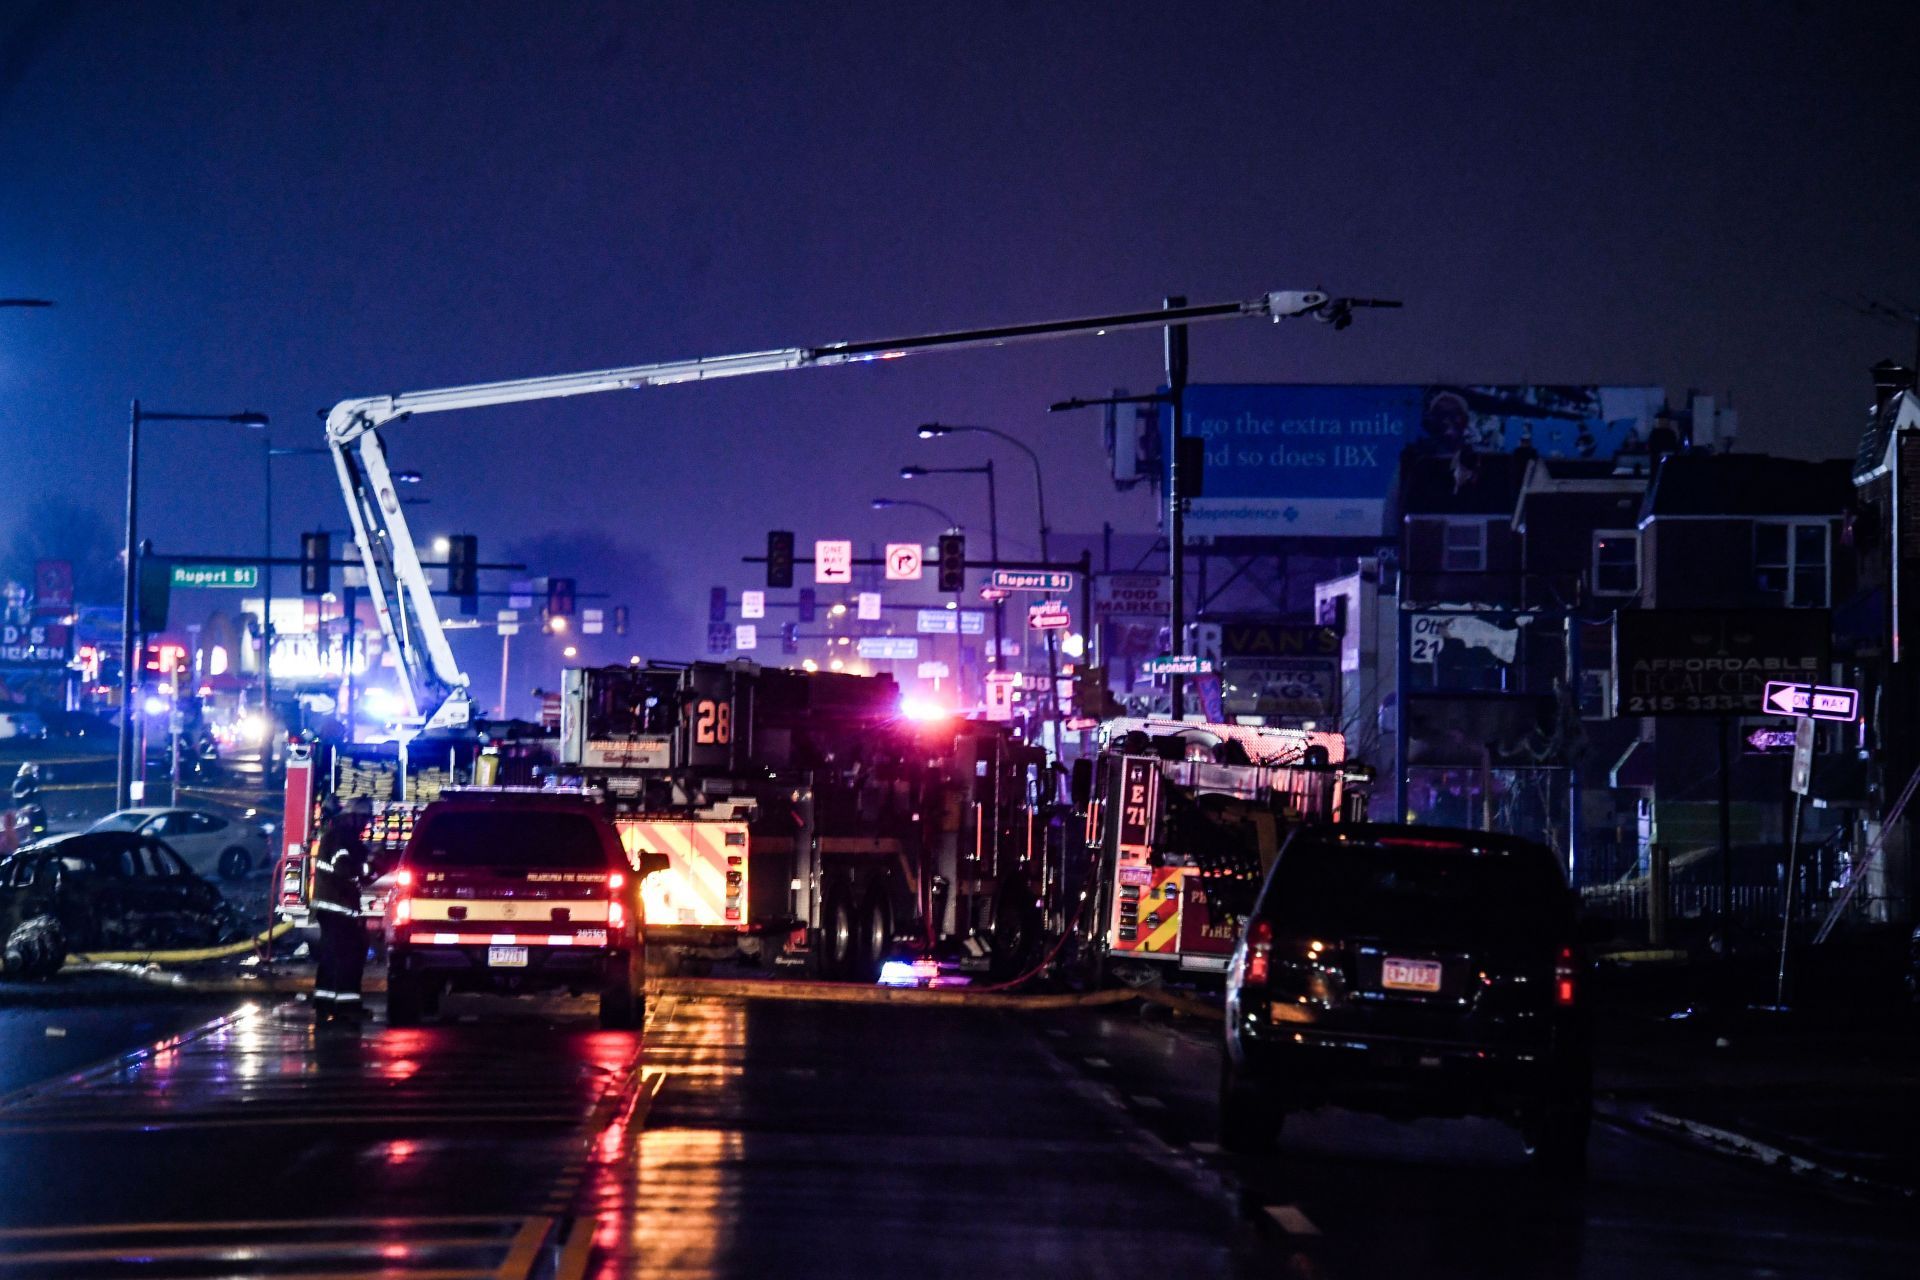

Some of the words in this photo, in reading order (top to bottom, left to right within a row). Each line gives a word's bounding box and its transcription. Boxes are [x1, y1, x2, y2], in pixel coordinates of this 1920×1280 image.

[1201, 418, 1229, 439] go
[1236, 412, 1275, 435] the
[1281, 416, 1342, 435] extra
[1350, 412, 1405, 436] mile
[1203, 444, 1230, 467] nd
[1237, 450, 1264, 467] so
[1269, 444, 1327, 467] does
[1334, 445, 1379, 468] IBX
[174, 568, 227, 584] Rupert
[233, 568, 250, 583] St
[998, 573, 1046, 588] Rupert
[1051, 575, 1067, 588] St
[1111, 590, 1158, 600] FOOD
[1229, 627, 1338, 652] VAN'S
[1152, 661, 1196, 673] Leonard
[1200, 661, 1212, 673] St
[1632, 656, 1818, 672] AFFORDABLE
[1249, 672, 1315, 682] AUTO
[1631, 672, 1713, 694] LEGAL
[1820, 697, 1846, 709] WAY
[696, 701, 731, 745] 28
[1132, 786, 1145, 804] E
[1126, 807, 1146, 826] 71
